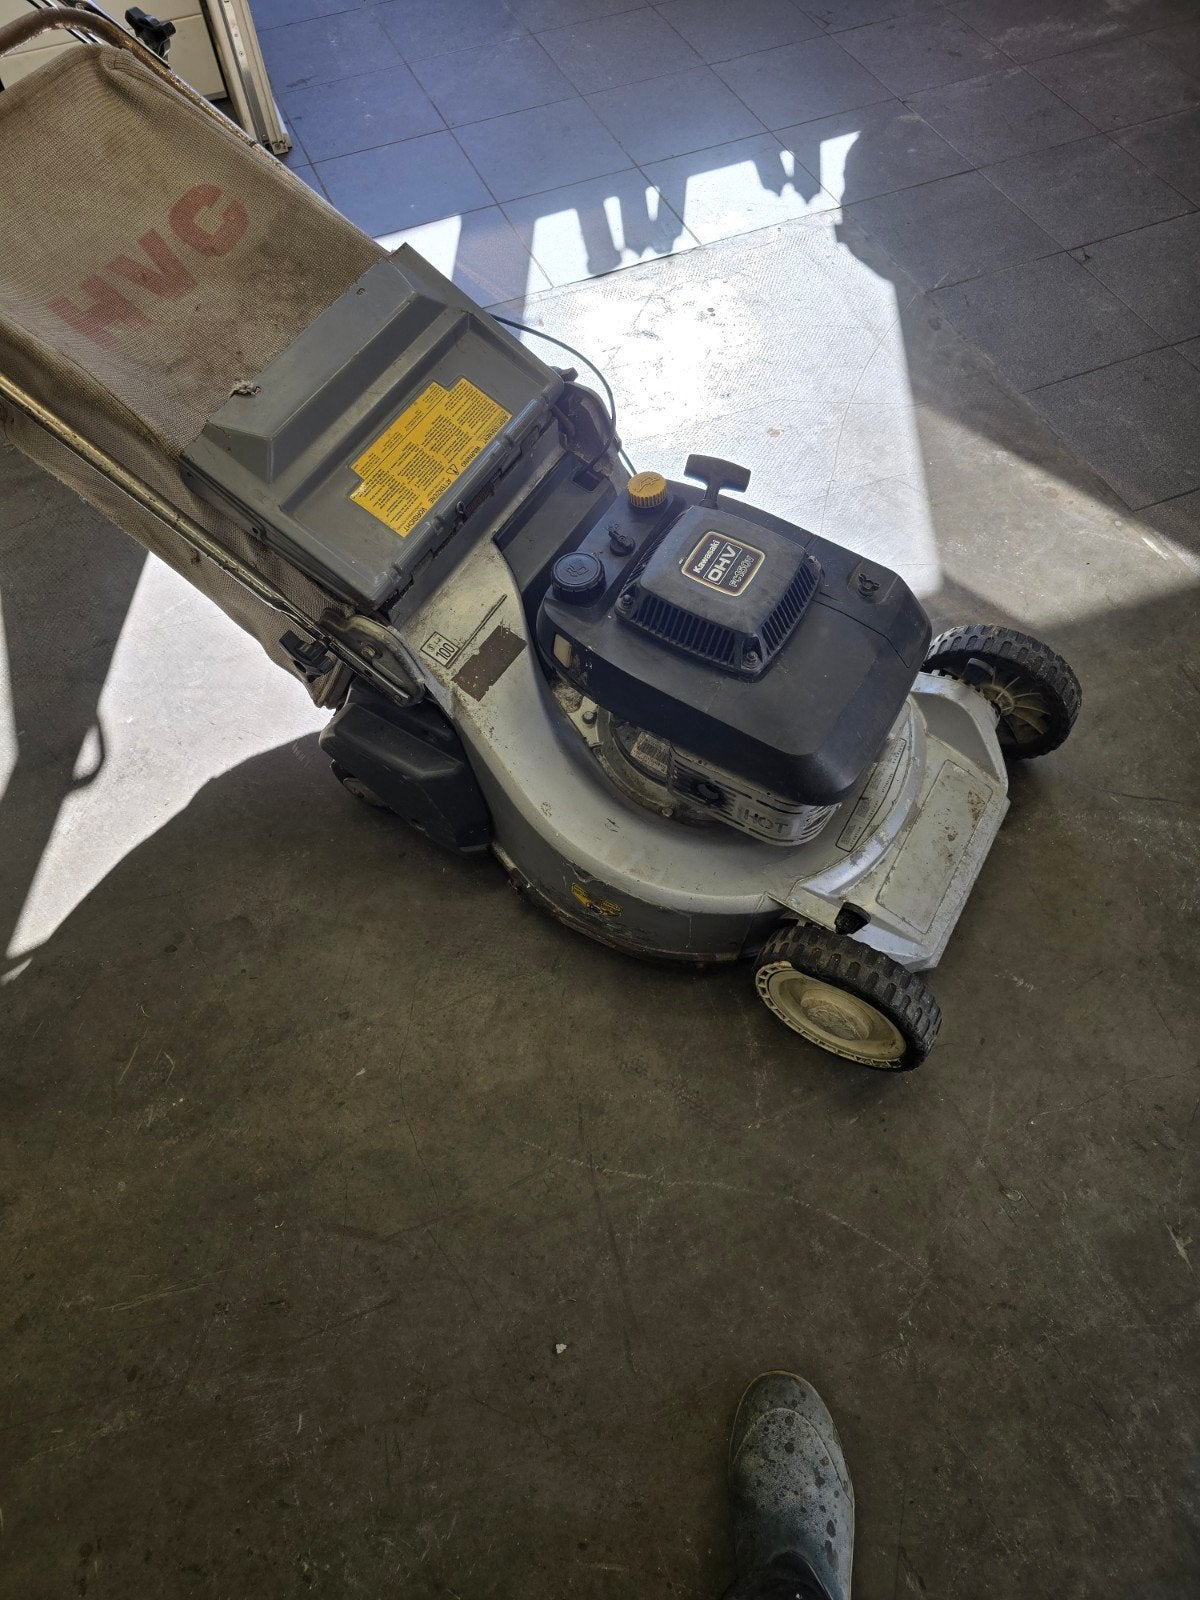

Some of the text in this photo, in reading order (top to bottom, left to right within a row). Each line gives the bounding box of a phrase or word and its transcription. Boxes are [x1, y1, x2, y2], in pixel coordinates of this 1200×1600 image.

[49, 183, 248, 349] HVC
[404, 507, 427, 533] VORSICHT
[692, 539, 720, 574] Kawasaki
[707, 545, 736, 582] OHV
[435, 642, 456, 661] 100
